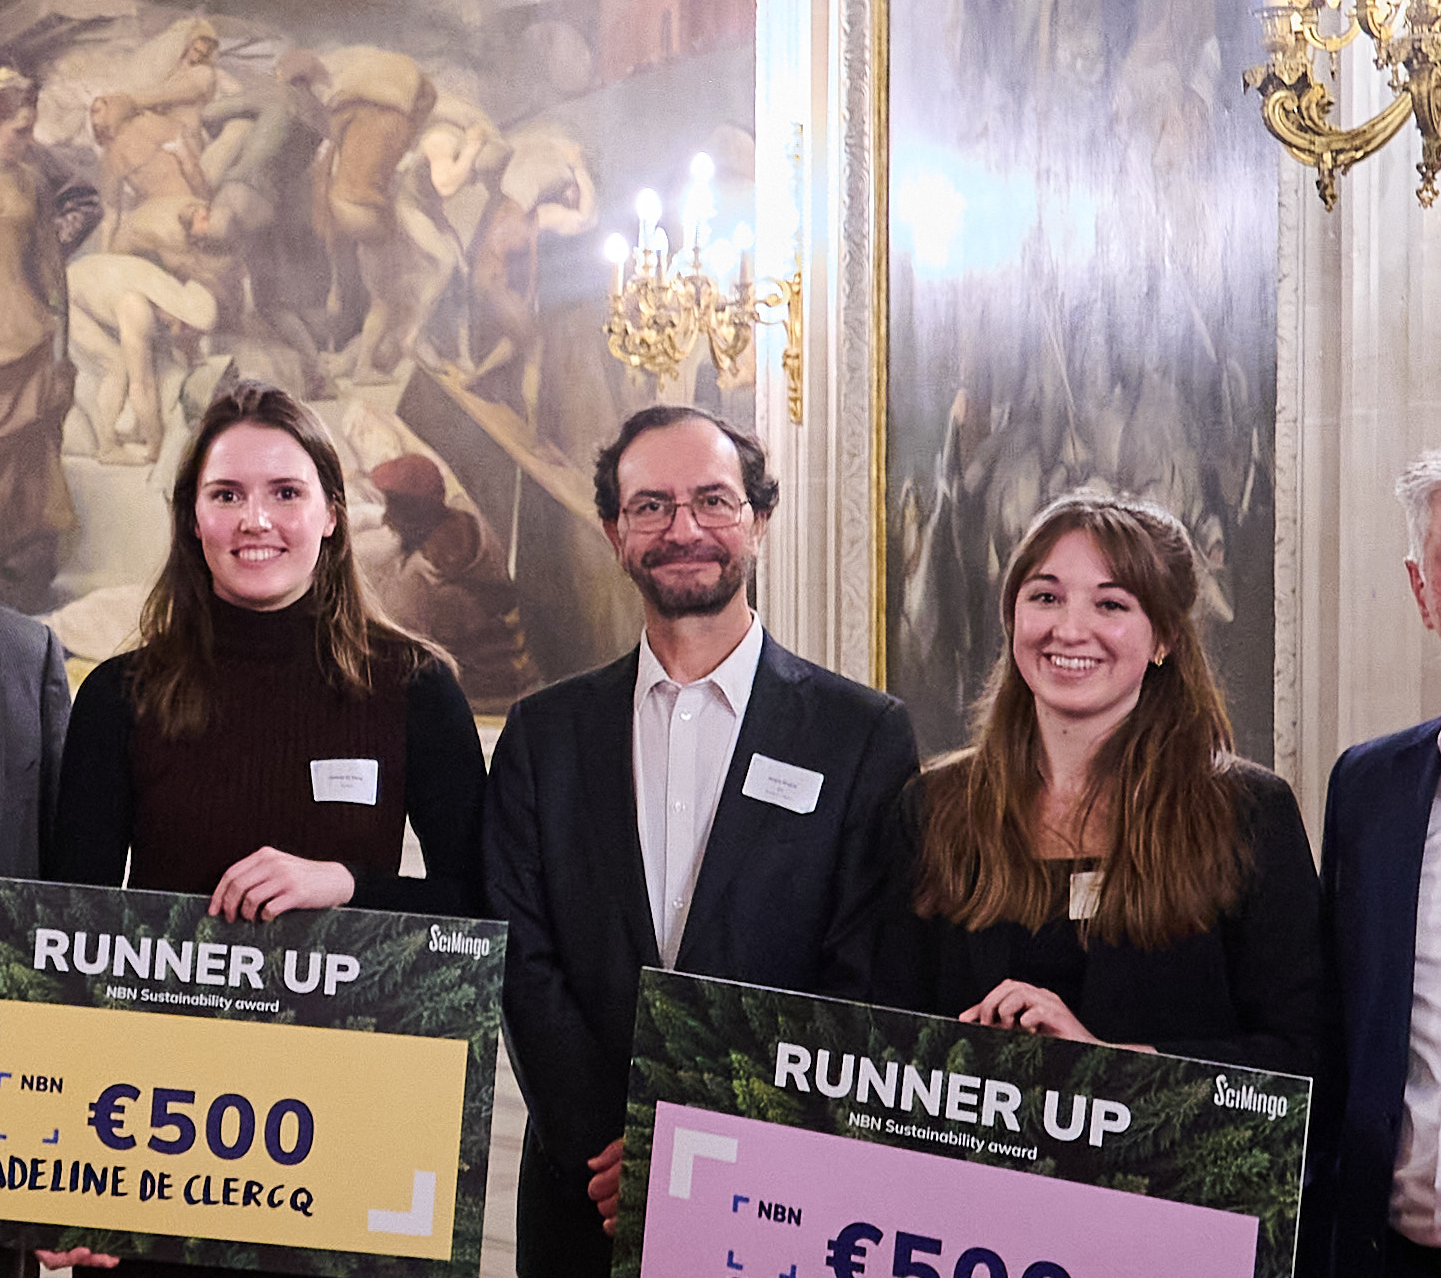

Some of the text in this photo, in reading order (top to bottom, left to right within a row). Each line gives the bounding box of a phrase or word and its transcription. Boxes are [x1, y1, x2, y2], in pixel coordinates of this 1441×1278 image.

[33, 929, 360, 996] RUNNER UP
[429, 925, 490, 960] SciMingo
[106, 985, 279, 1013] NBN Sustainability award
[21, 1074, 63, 1094] NBN
[774, 1042, 1132, 1147] RUNNER UP
[1214, 1074, 1288, 1121] SciMingo
[88, 1083, 315, 1166] €500
[849, 1112, 1038, 1161] NBN Sustainability award
[139, 1171, 173, 1201] DE
[184, 1173, 314, 1217] CLERCQ
[758, 1201, 802, 1226] NBN
